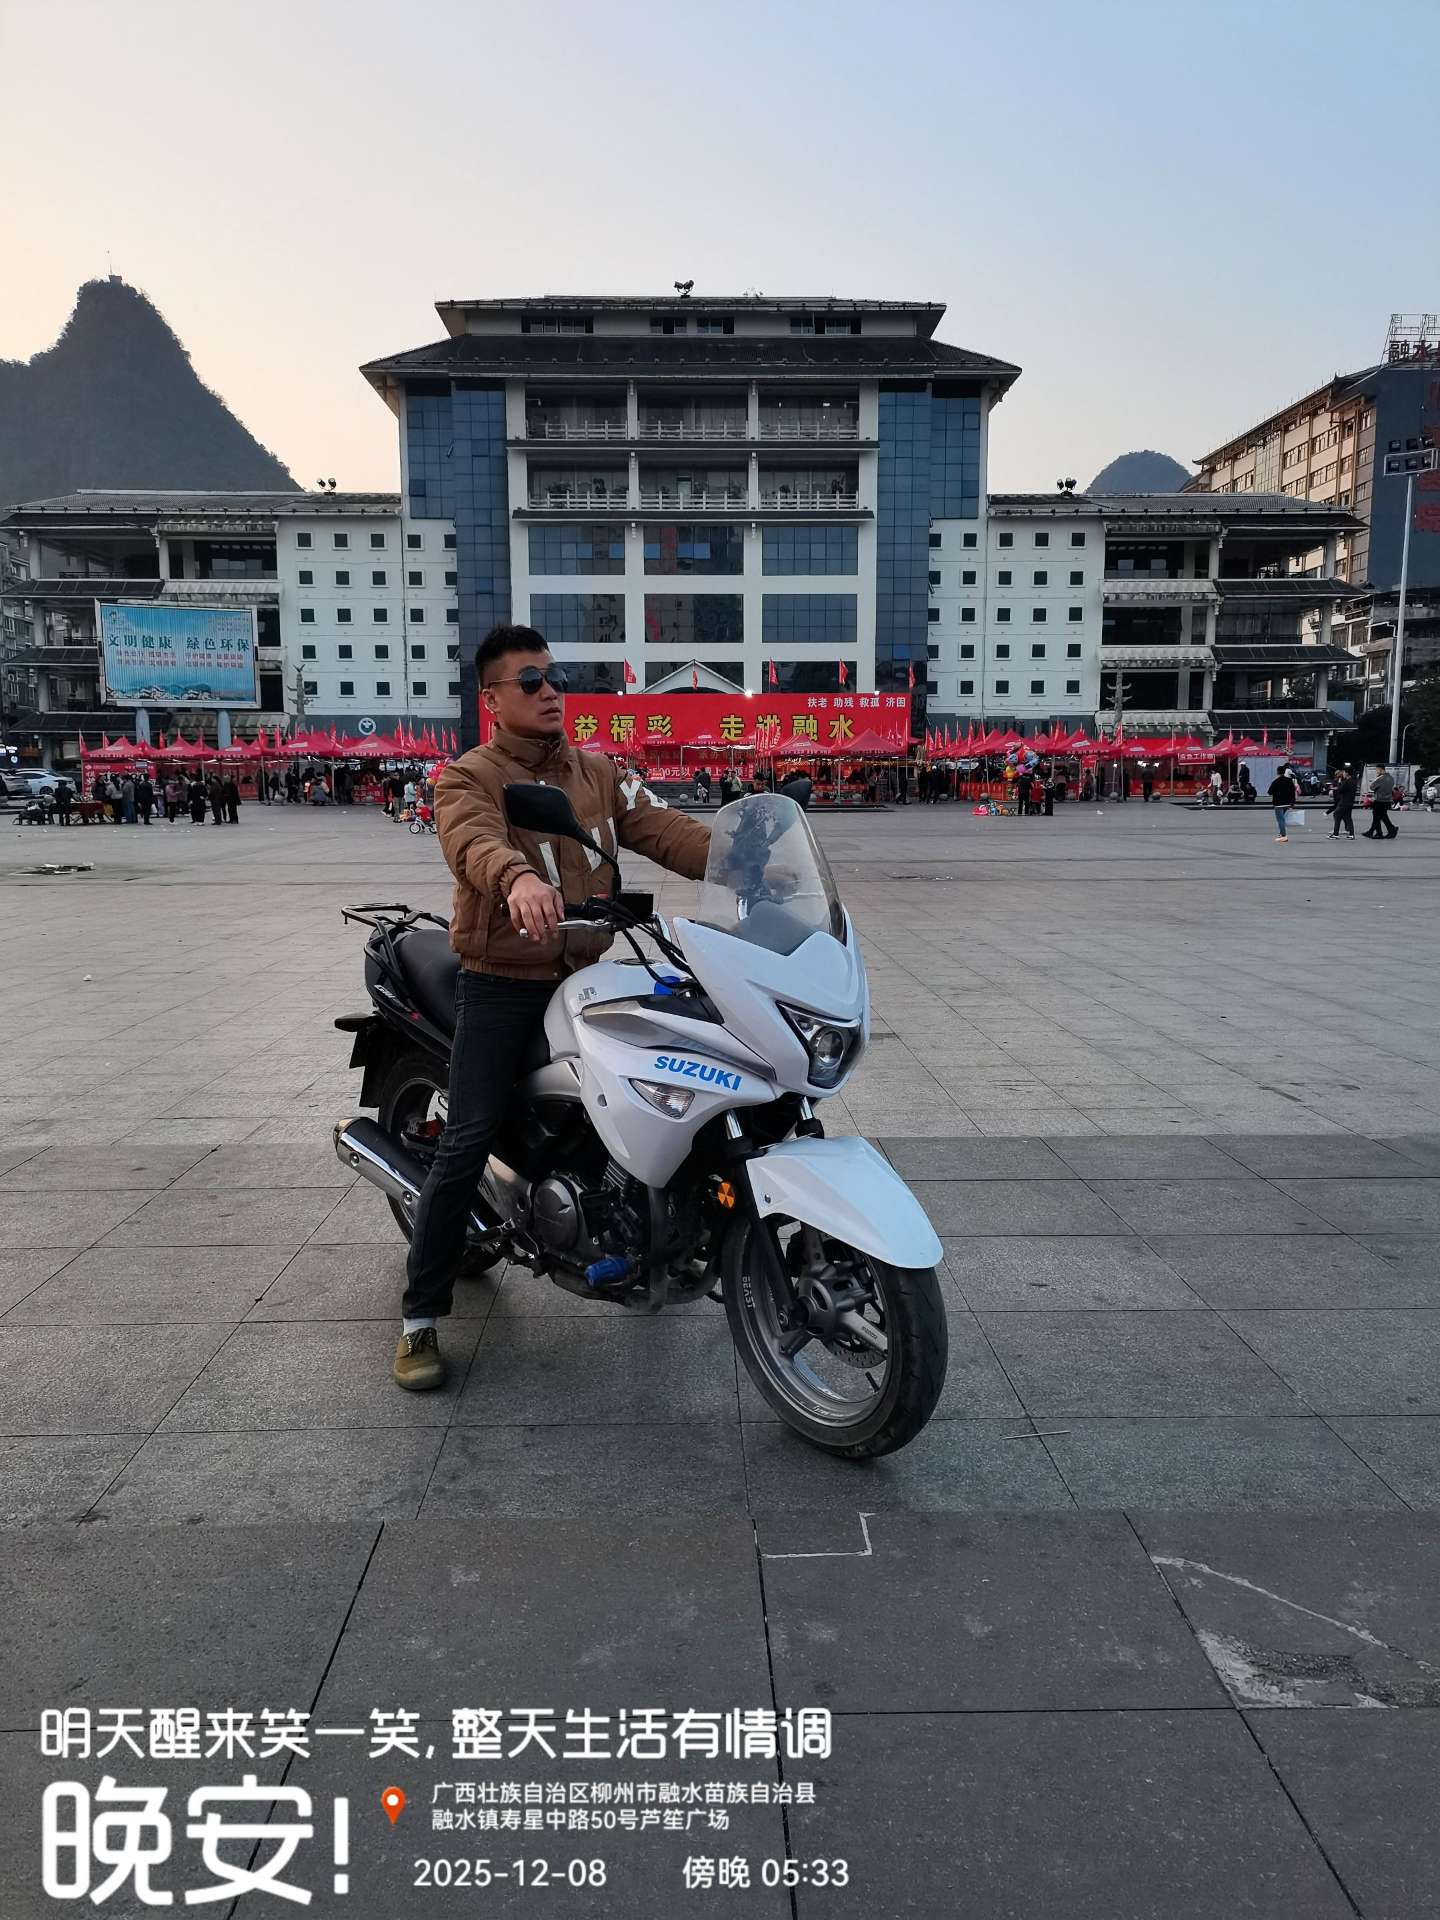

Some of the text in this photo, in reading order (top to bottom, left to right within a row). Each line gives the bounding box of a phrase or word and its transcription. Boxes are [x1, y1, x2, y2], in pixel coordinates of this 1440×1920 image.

[107, 633, 249, 652] 文明健康 绿色环保
[807, 697, 906, 709] 扶老 助残 救孤 济困
[654, 1055, 742, 1091] SUZUKI
